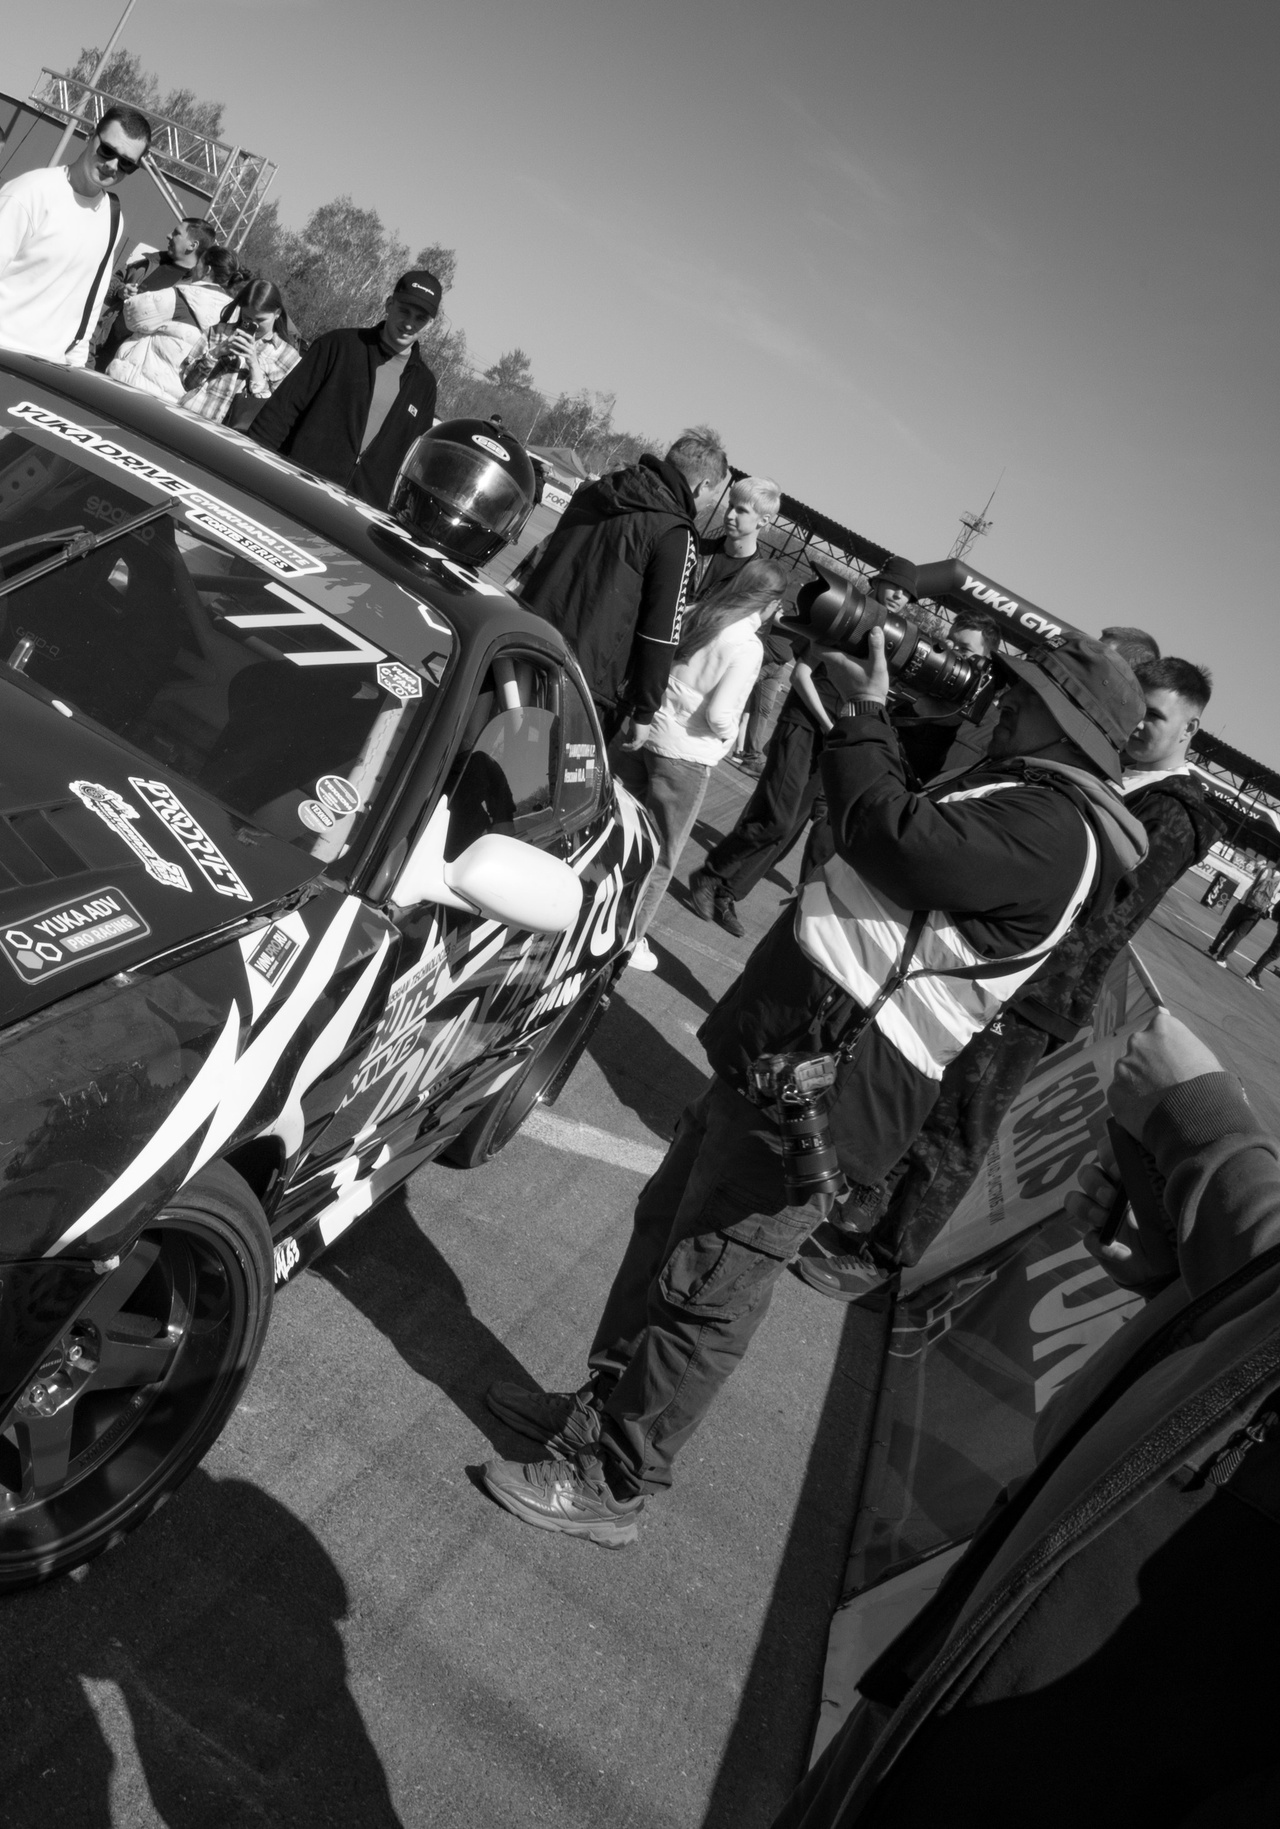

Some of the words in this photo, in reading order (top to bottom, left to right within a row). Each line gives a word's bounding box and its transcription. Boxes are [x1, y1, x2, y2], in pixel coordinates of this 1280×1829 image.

[16, 405, 93, 444] YUKA
[91, 443, 191, 493] DRIVE
[86, 495, 155, 541] sparo
[189, 493, 285, 549] GYMKHANA
[268, 540, 311, 568] LITE
[200, 513, 245, 549] FORTIS
[240, 539, 291, 570] SERIES
[960, 574, 1019, 619] YUKA
[391, 665, 418, 685] YUKA
[33, 908, 93, 938] YUKA
[82, 895, 122, 921] ADV
[66, 932, 95, 950] PRO
[94, 917, 134, 941] RACING
[253, 929, 288, 974] VINILPRO.RU
